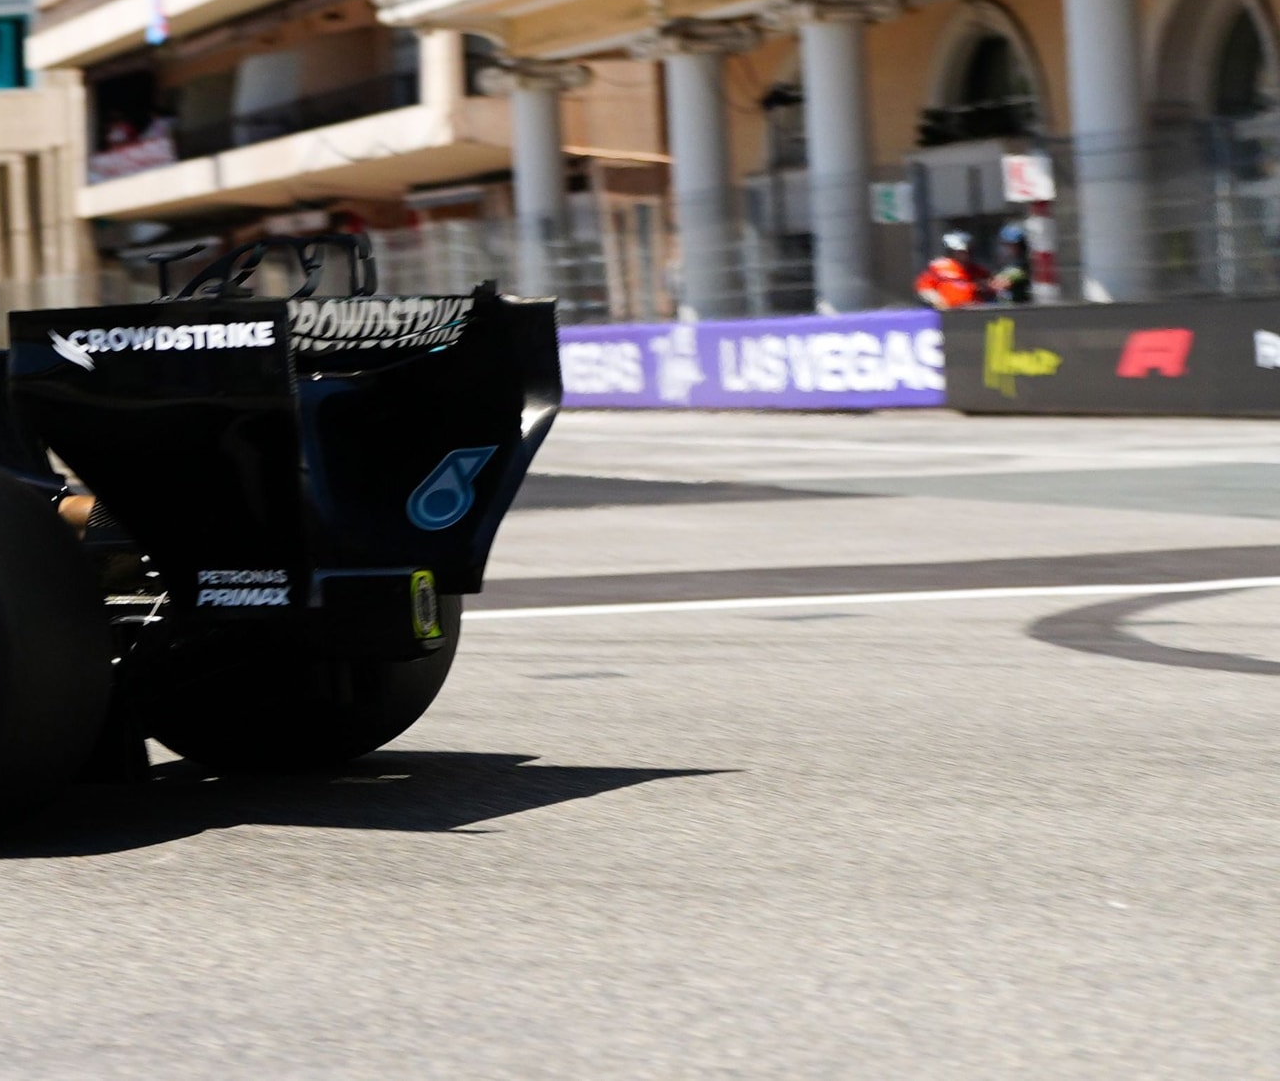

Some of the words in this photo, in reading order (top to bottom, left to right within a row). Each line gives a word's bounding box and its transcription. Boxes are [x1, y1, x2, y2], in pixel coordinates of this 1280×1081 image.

[67, 320, 275, 354] CROWDSTRIKE
[197, 569, 289, 585] PETRONAS
[196, 587, 291, 607] PRIMAX
